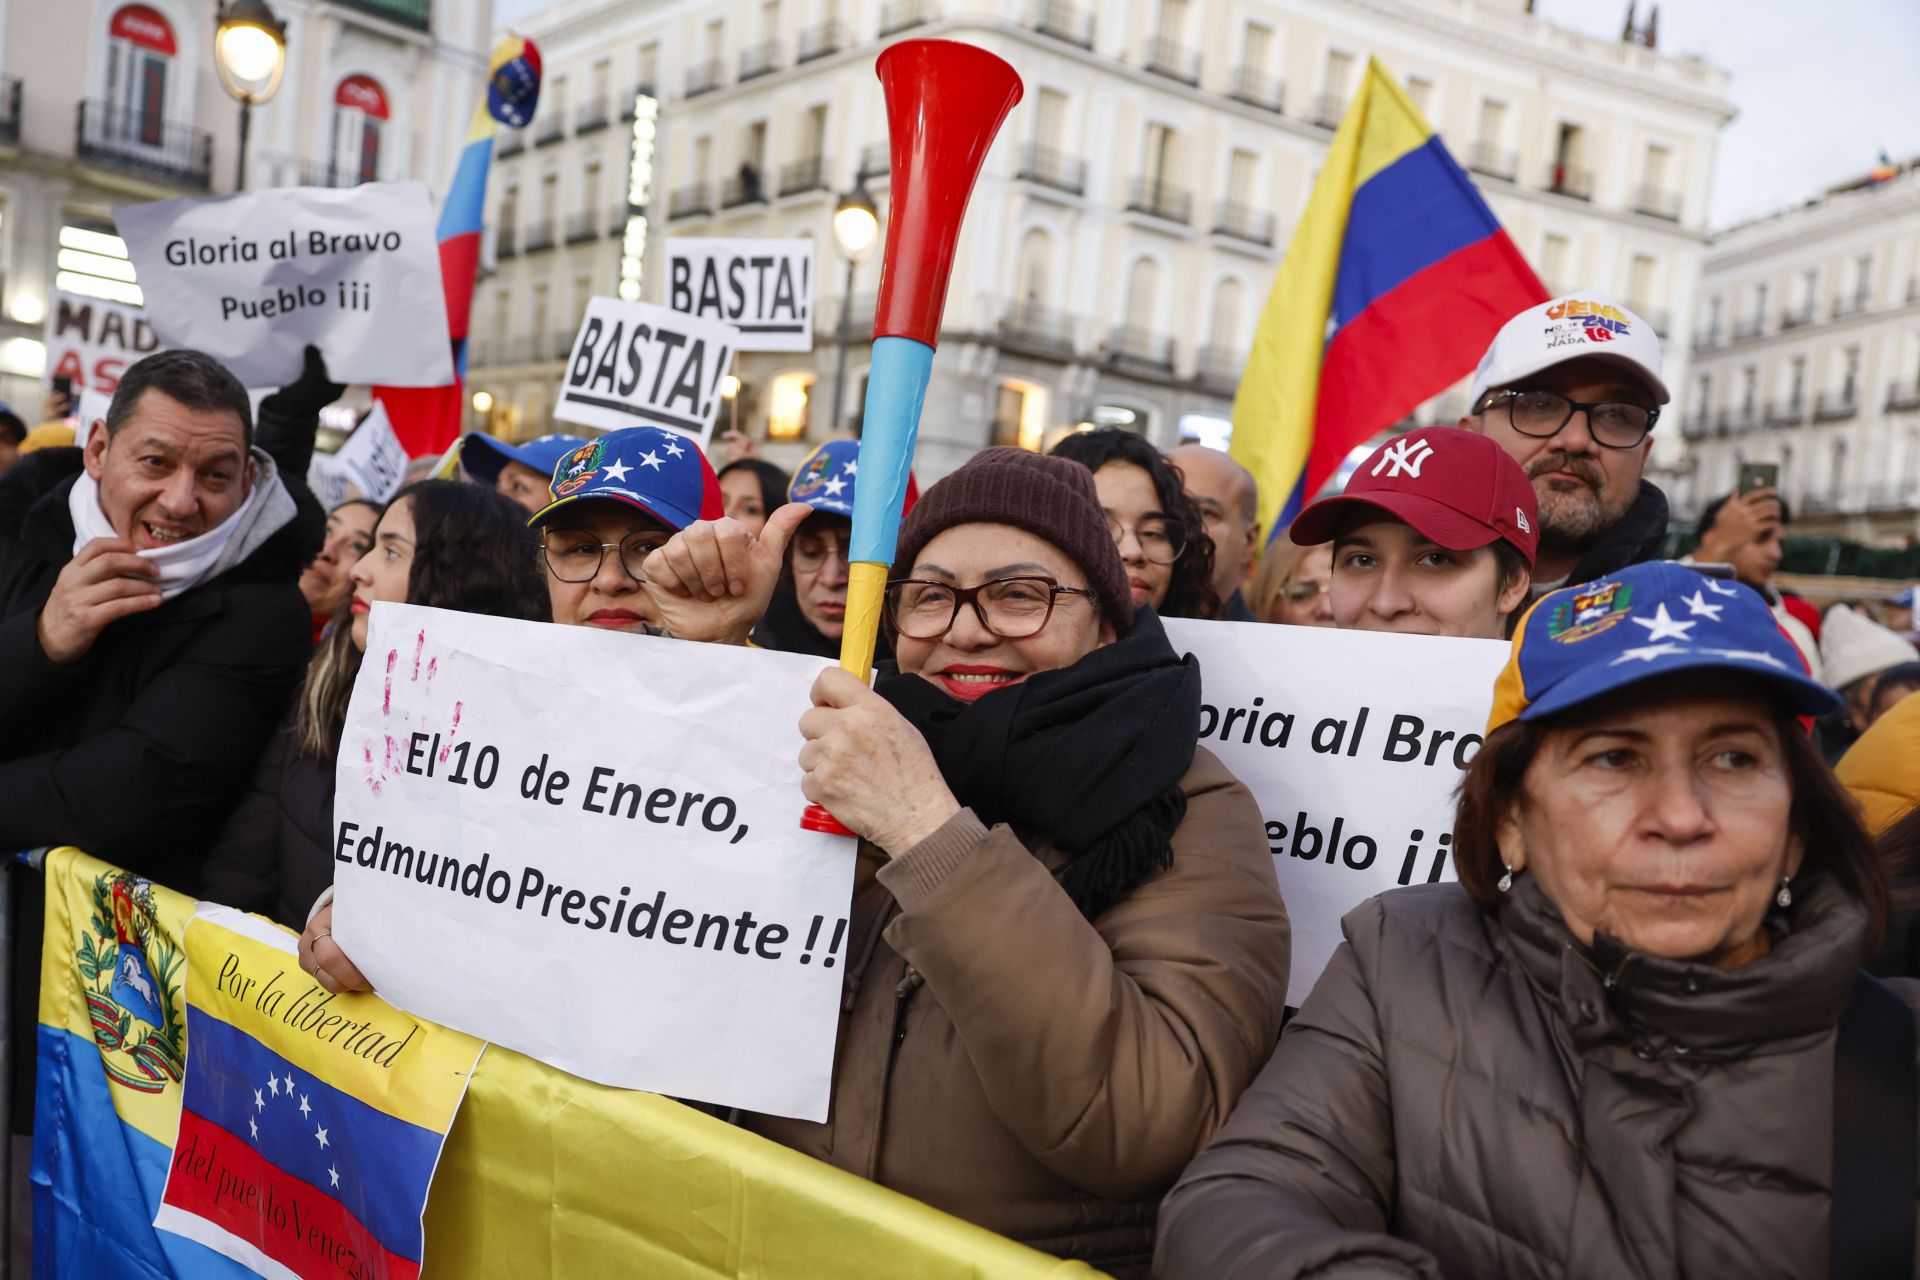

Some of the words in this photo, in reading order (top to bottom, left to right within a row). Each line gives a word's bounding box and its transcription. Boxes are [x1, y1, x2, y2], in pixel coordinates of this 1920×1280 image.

[164, 235, 258, 266] Gloria
[269, 230, 297, 260] al
[308, 230, 402, 255] Bravo
[671, 256, 808, 320] BASTA!
[220, 284, 326, 320] Pueblo
[569, 317, 728, 419] BASTA!
[1371, 438, 1434, 479] NY
[1311, 706, 1370, 757] al
[406, 732, 439, 777] El
[447, 741, 500, 790] 10
[520, 754, 570, 805] de
[582, 766, 750, 845] Enero,
[335, 822, 511, 904] Edmundo
[515, 867, 789, 961] Presidente
[800, 915, 848, 968] !!
[216, 952, 257, 1002] Por
[255, 970, 285, 1018] la
[283, 984, 420, 1069] libertad
[175, 1135, 217, 1184] del
[214, 1166, 287, 1231] pueblo
